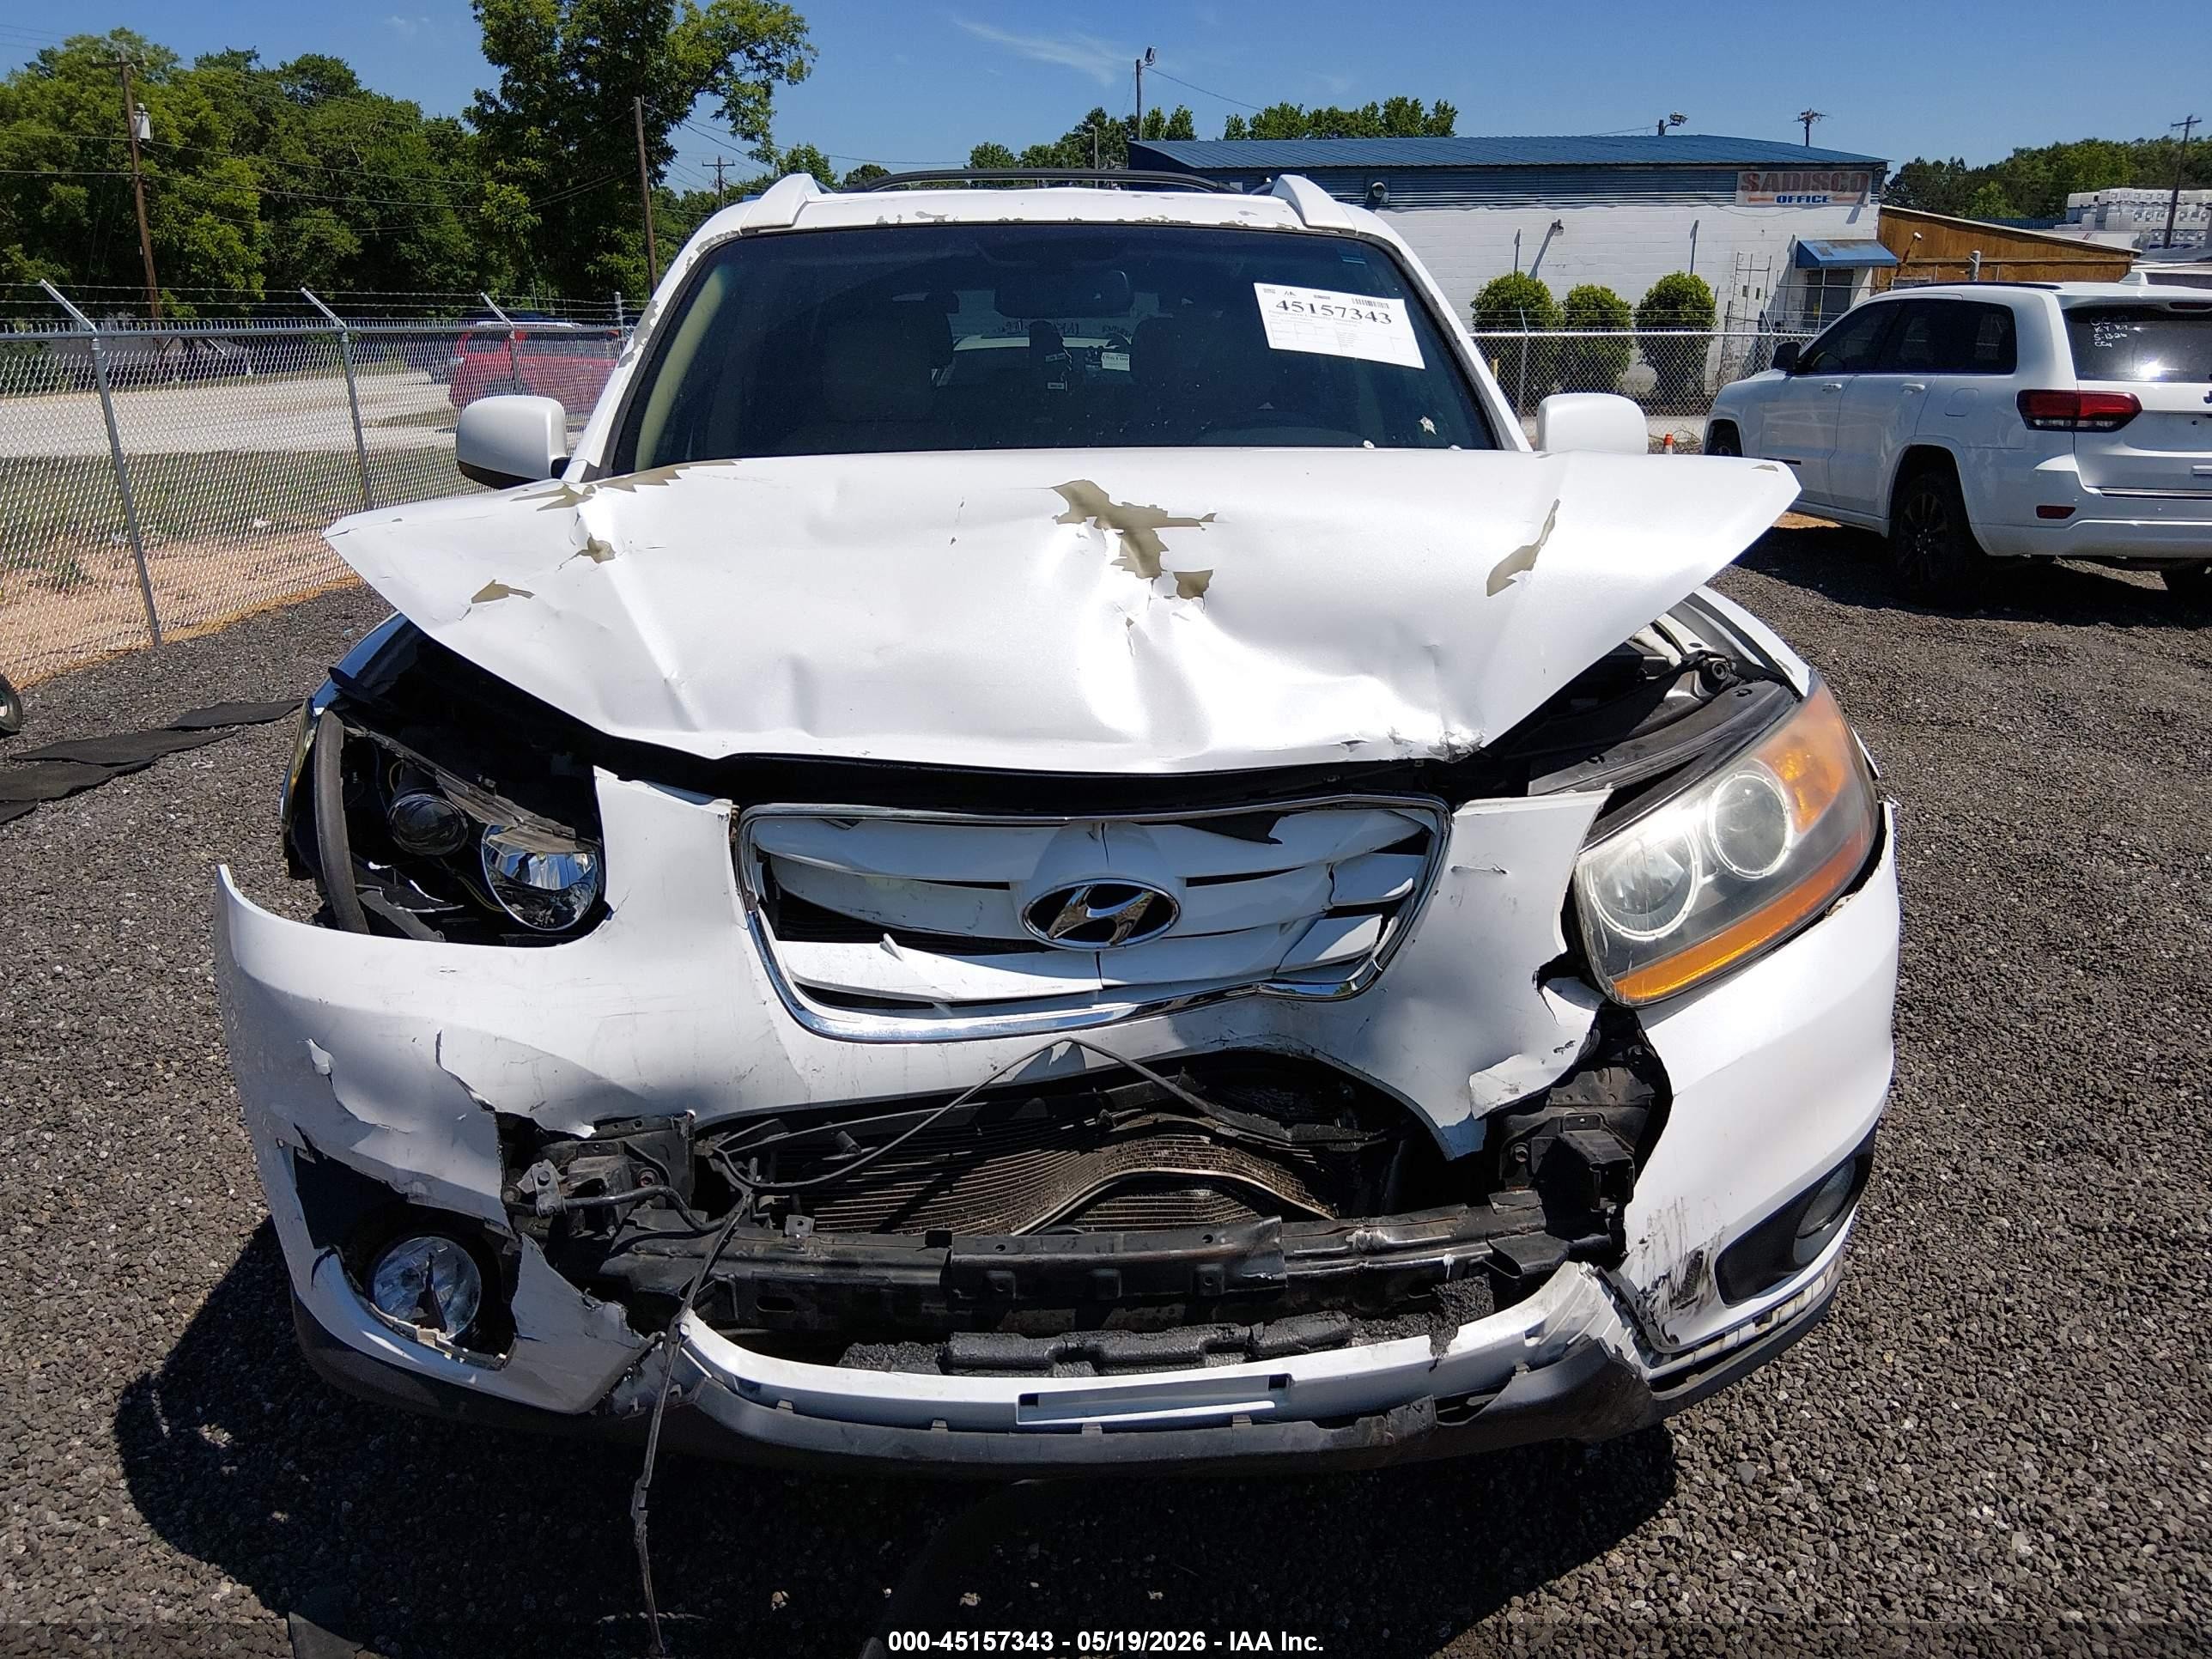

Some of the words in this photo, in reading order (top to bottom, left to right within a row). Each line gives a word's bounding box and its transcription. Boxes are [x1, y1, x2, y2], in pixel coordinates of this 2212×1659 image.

[1741, 172, 1869, 192] SADISCO
[1776, 195, 1830, 204] OFFICE
[1275, 300, 1392, 325] 45157343
